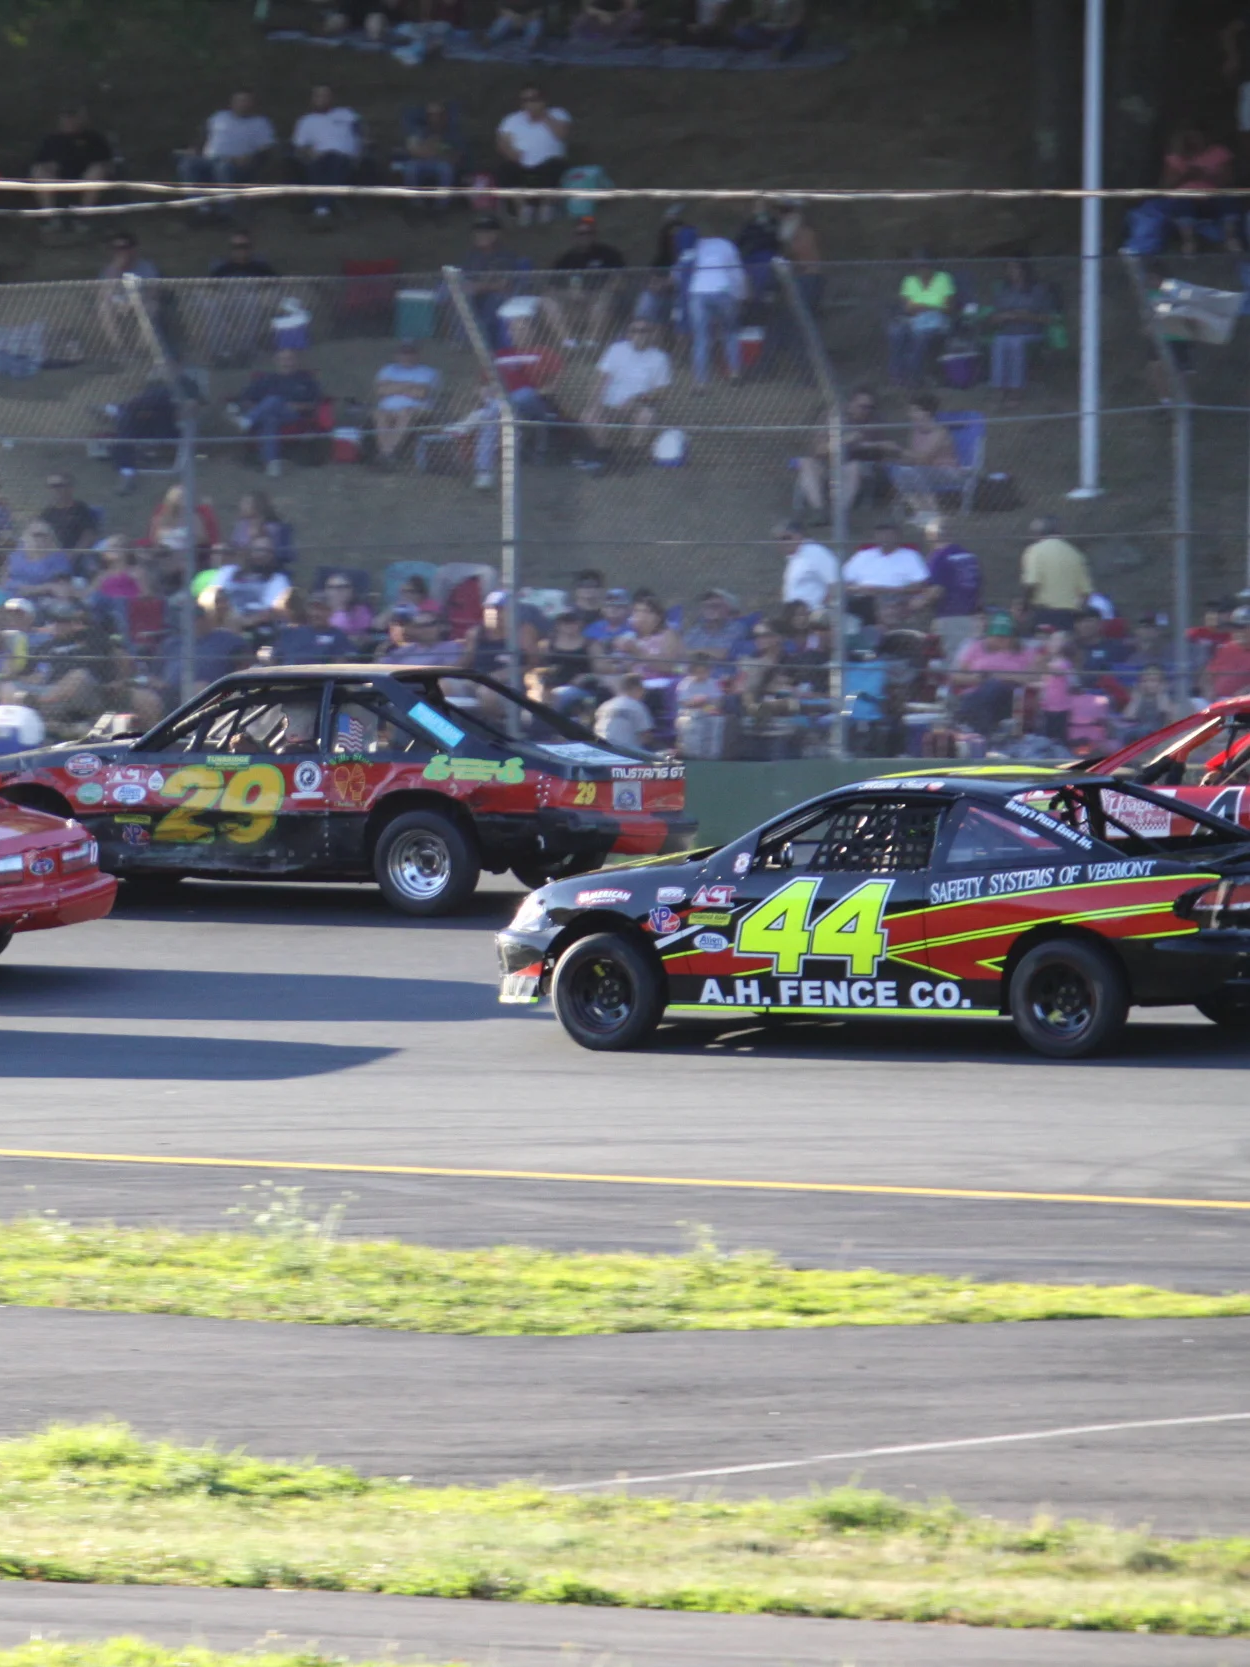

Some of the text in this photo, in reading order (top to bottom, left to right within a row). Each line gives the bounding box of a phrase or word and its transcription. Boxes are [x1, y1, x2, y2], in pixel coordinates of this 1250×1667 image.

[612, 767, 684, 779] MUSTANG GT
[152, 763, 285, 844] 29
[573, 781, 597, 805] 29
[1034, 812, 1058, 829] Pizza
[930, 860, 1157, 905] SAFETY SYSTEMS OF VERMONT
[650, 907, 671, 932] VP
[733, 876, 896, 979] 44
[700, 978, 972, 1008] A.H. FENCE CO.
